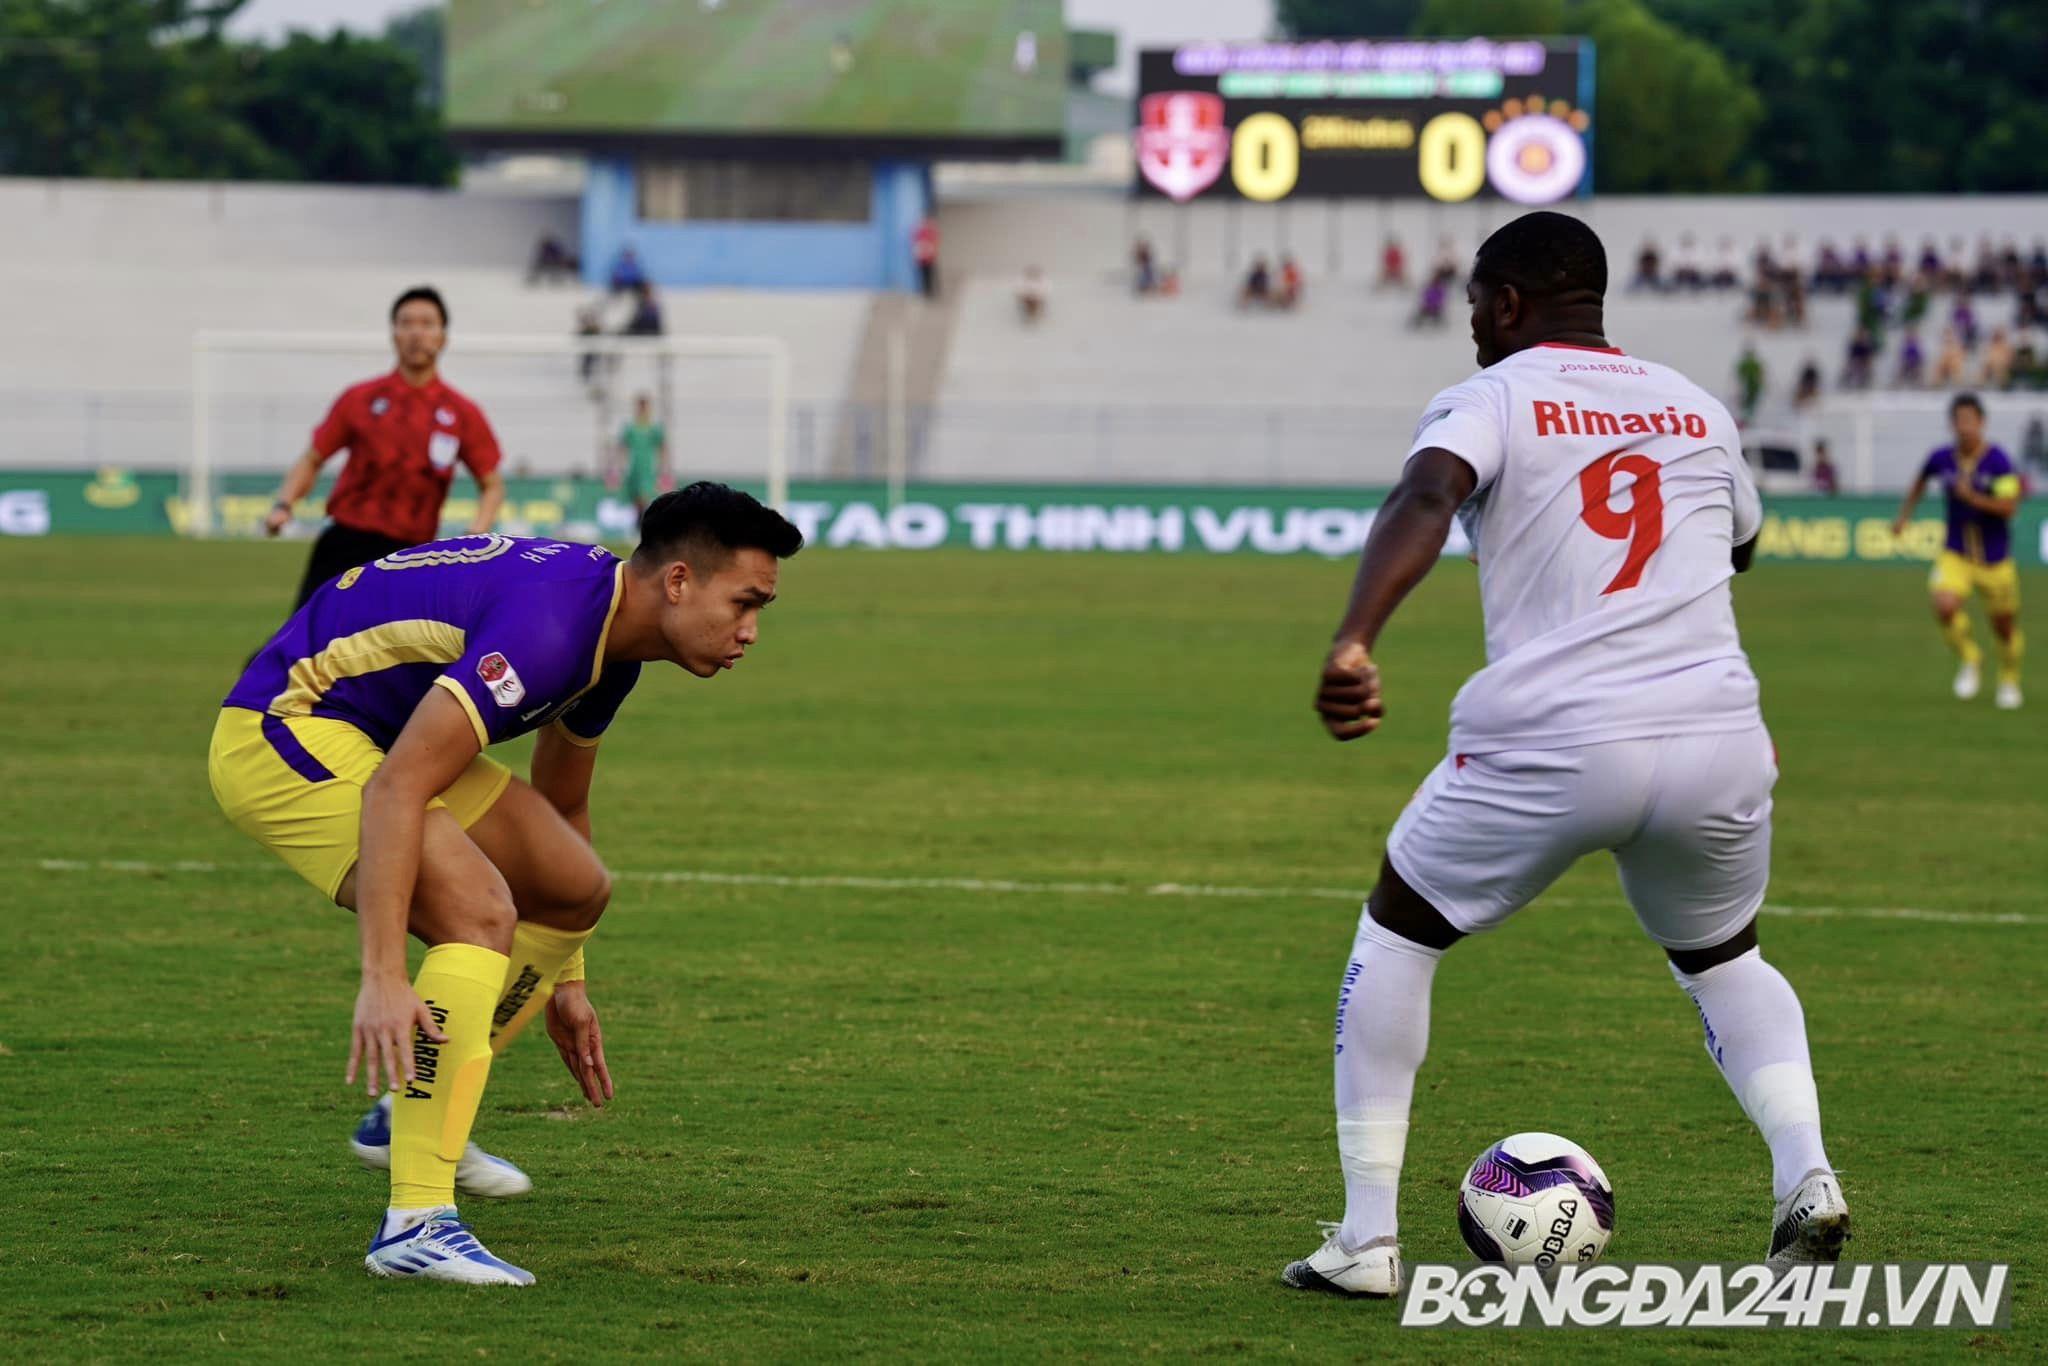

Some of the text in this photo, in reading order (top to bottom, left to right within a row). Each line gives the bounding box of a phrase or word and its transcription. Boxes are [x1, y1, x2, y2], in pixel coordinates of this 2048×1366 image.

[1231, 112, 1299, 201] 0
[1419, 112, 1486, 201] 0
[1533, 400, 1708, 439] Rimario
[1579, 449, 1663, 596] 9
